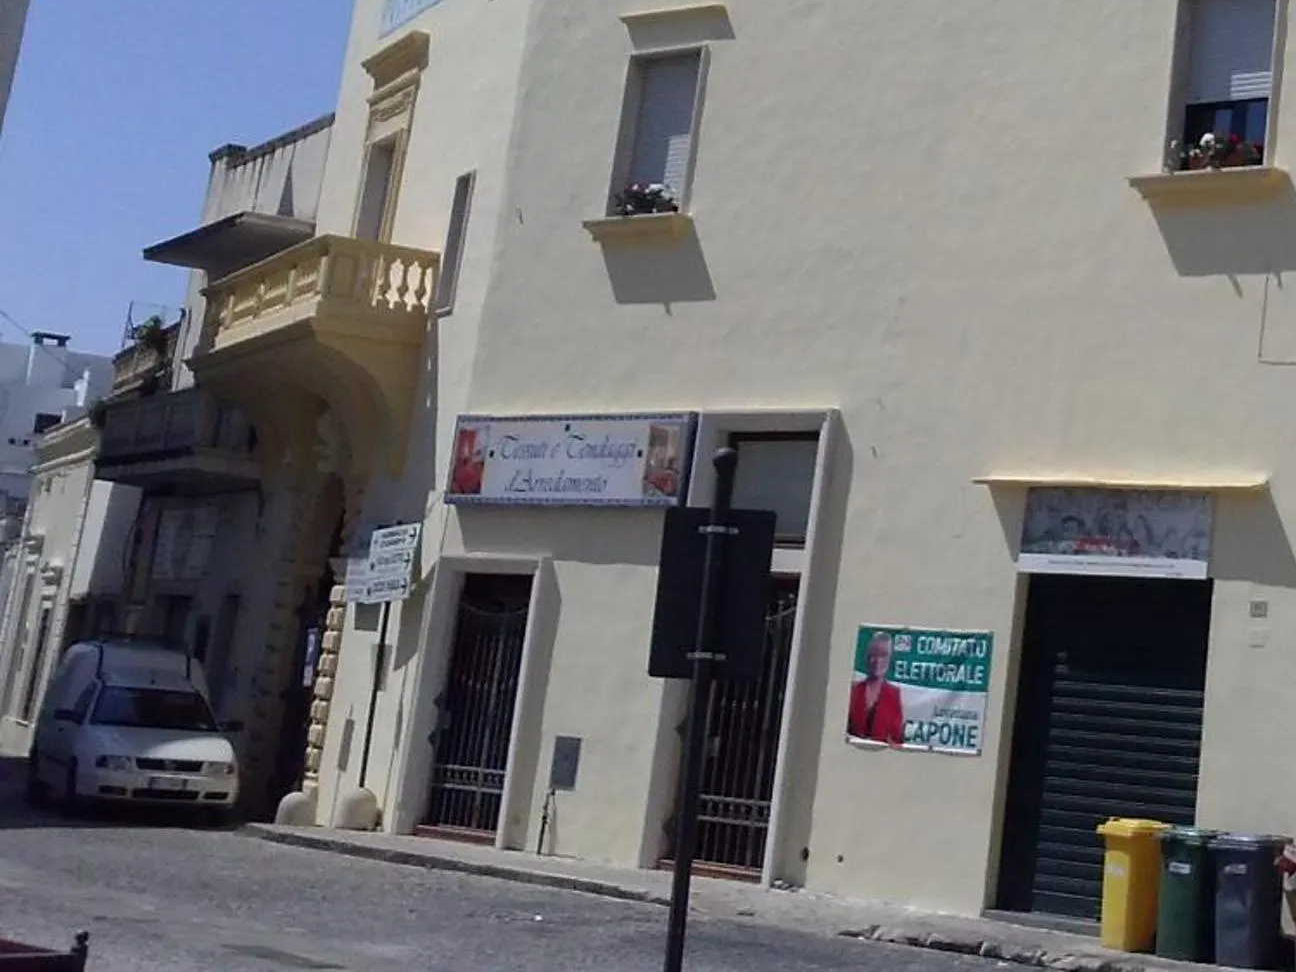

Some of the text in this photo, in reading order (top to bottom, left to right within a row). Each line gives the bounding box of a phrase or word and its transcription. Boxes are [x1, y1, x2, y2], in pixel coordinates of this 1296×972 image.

[917, 636, 987, 658] COMITATO
[894, 660, 985, 685] ELETTORALE
[902, 719, 980, 748] CAPONE
